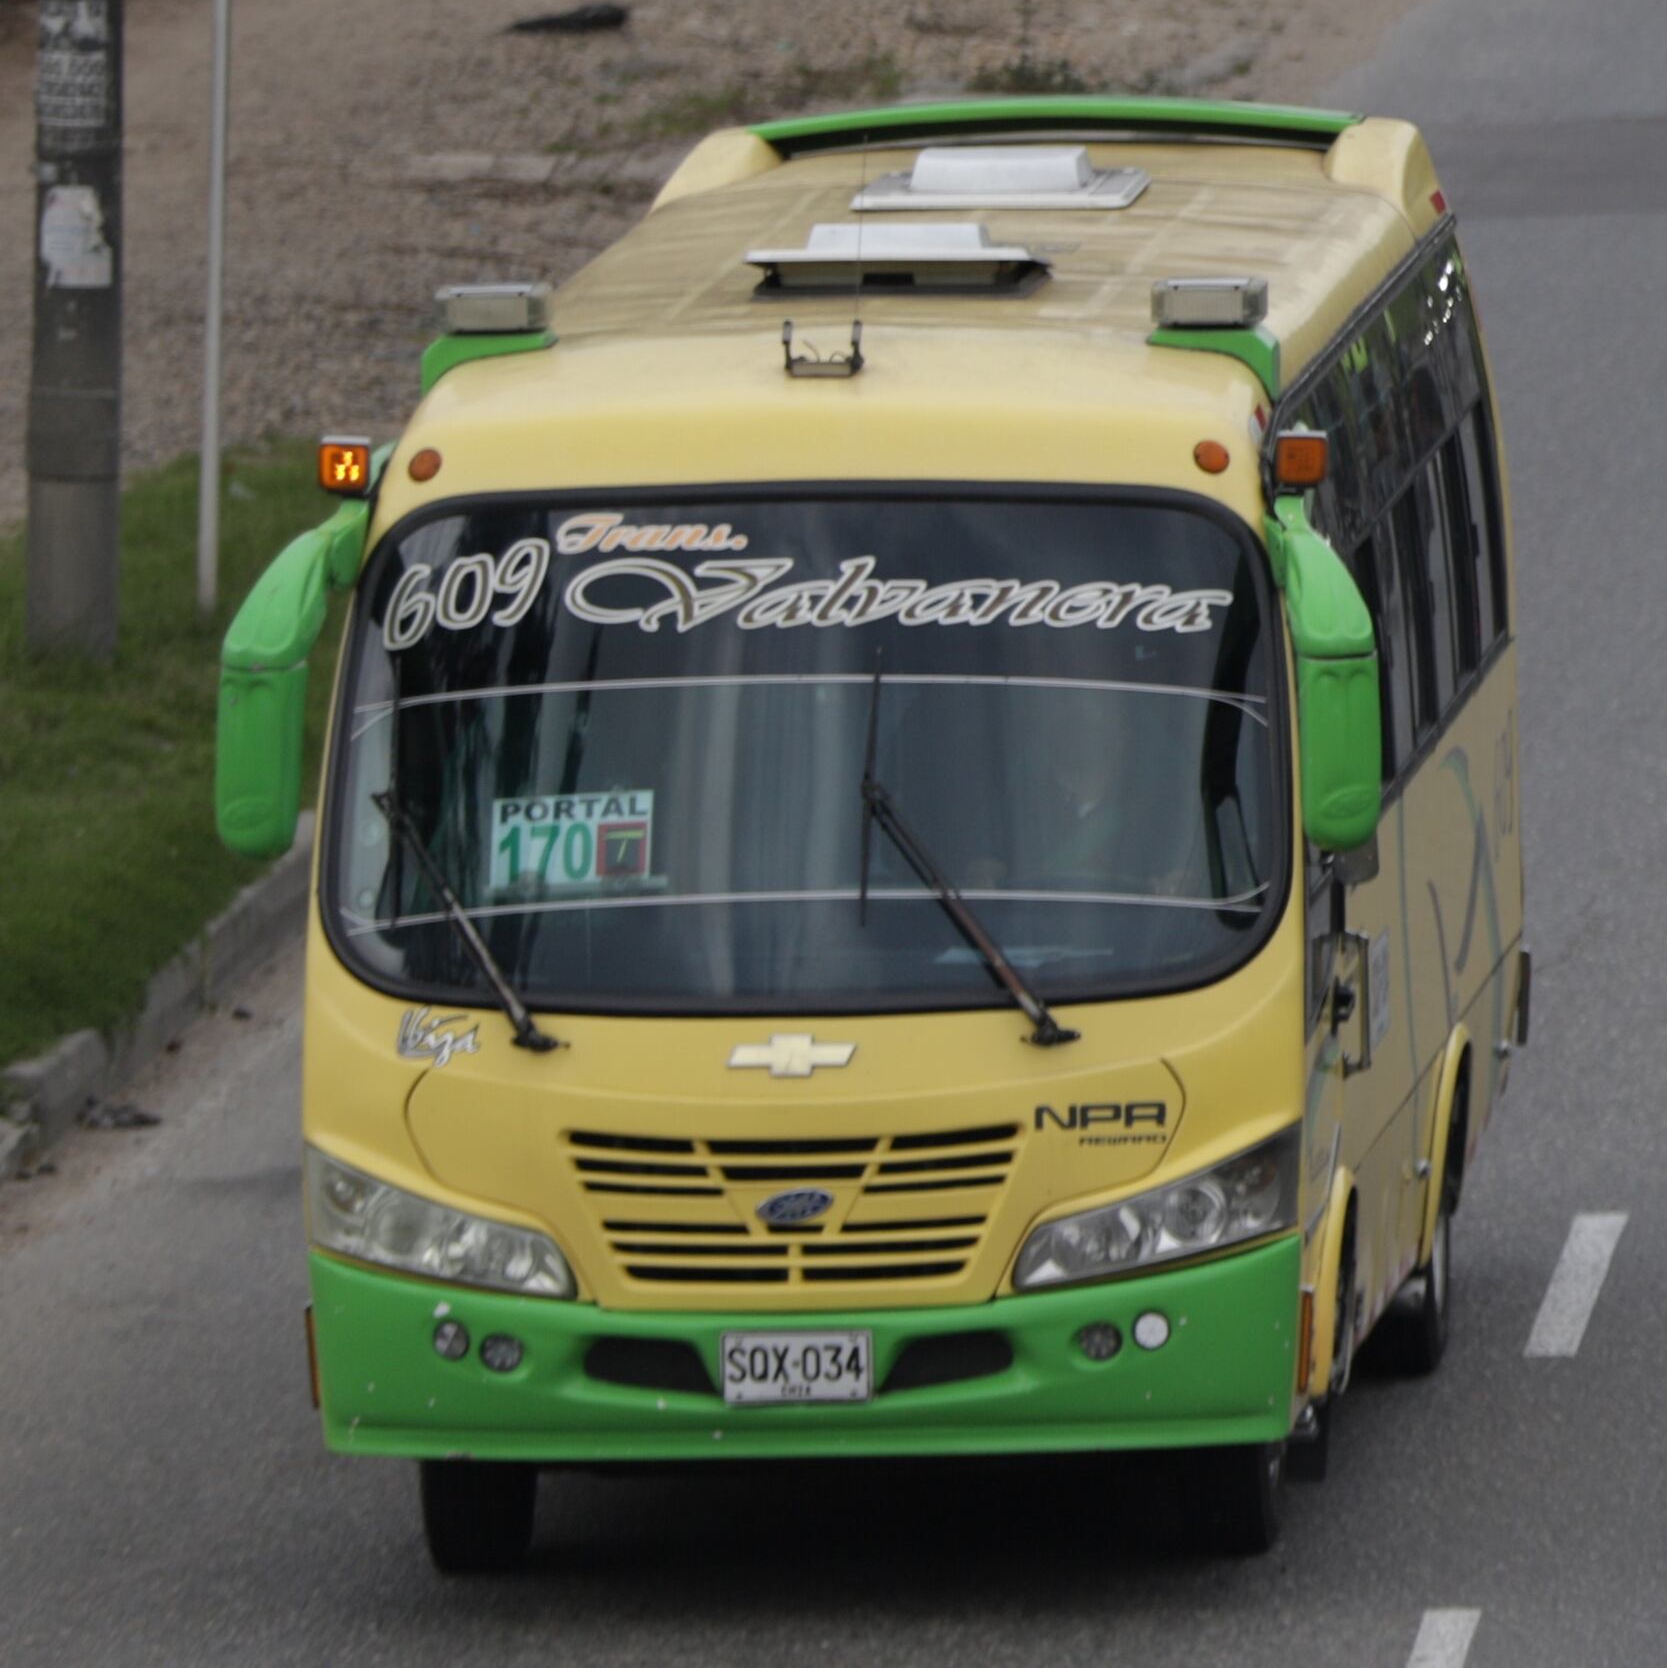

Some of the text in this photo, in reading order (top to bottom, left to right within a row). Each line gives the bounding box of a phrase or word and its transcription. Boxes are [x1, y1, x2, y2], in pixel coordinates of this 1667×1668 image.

[556, 512, 749, 554] Trans.
[383, 538, 1233, 651] 609 Valvanera
[500, 795, 649, 825] PORTAL
[498, 821, 593, 884] 170
